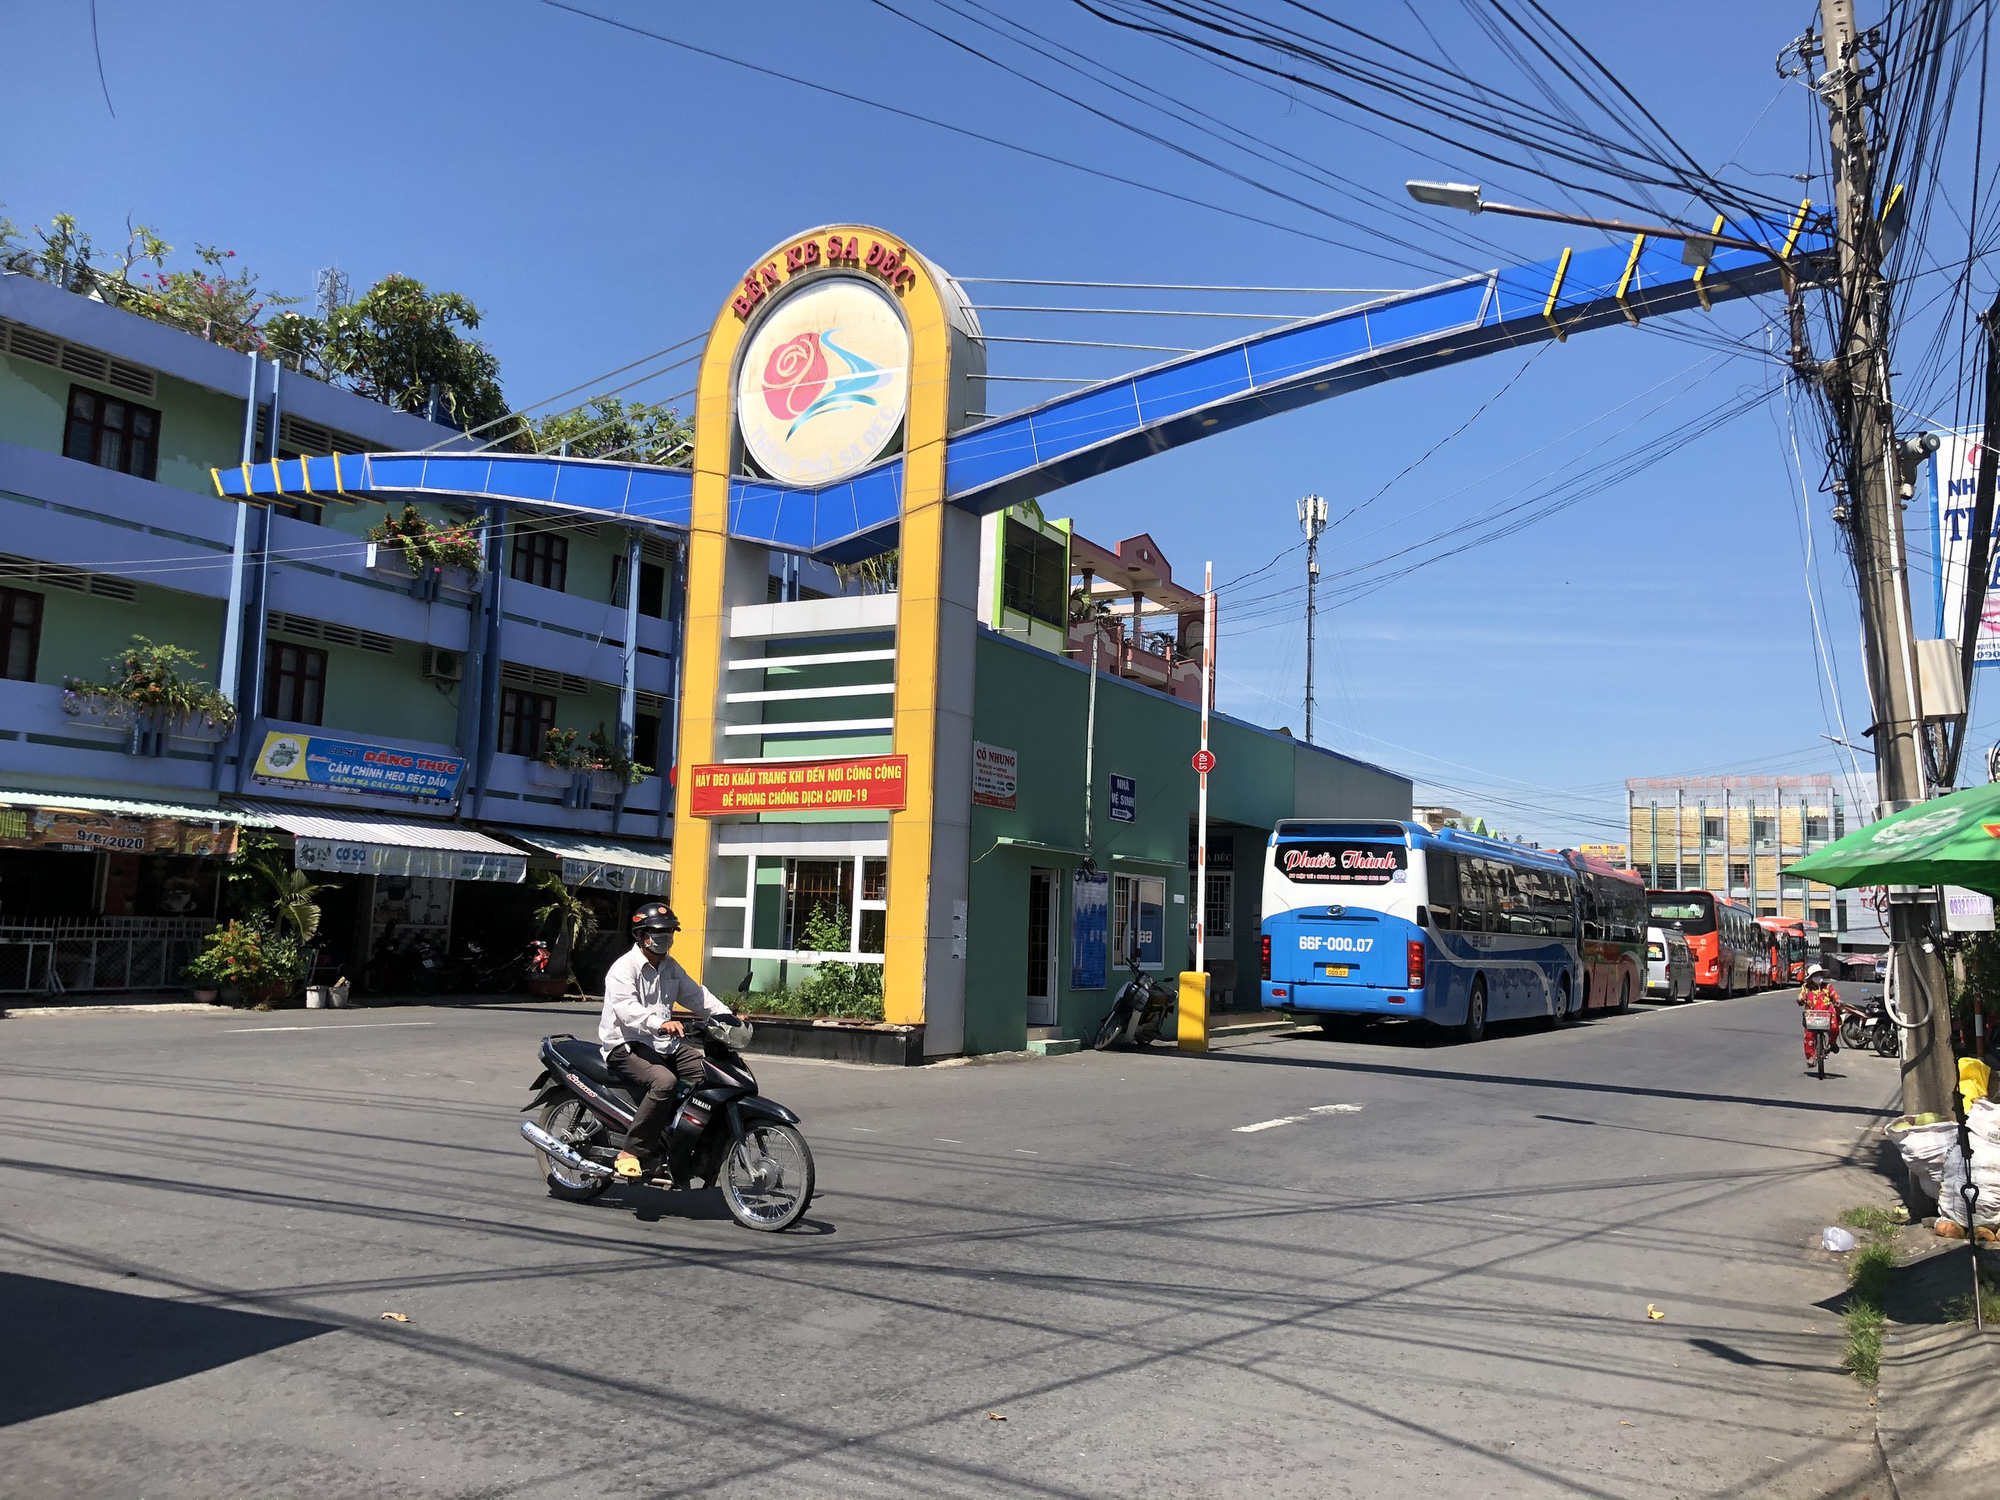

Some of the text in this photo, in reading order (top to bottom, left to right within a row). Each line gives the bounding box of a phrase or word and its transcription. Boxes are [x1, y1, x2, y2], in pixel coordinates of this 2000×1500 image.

[732, 261, 780, 318] BẾN
[785, 240, 819, 273] XE
[827, 236, 859, 261] SA
[838, 443, 863, 467] SA
[364, 751, 460, 774] ĐẶNG THỨC
[976, 747, 1016, 767] CÔ NHUNG
[1199, 753, 1208, 770] STOP
[385, 770, 405, 782] HEO
[712, 773, 730, 787] ĐEO
[731, 768, 756, 786] KHẨU
[758, 771, 787, 785] TRANG
[789, 770, 805, 783] KHI
[806, 765, 825, 783] ĐẾN
[827, 768, 844, 782] NƠI
[846, 765, 872, 780] CÔNG
[874, 764, 902, 783] CỘNG
[1116, 779, 1130, 791] NHÀ
[722, 787, 868, 806] ĐỂ PHÒNG CHỐNG DỊCH COVID-19
[1111, 791, 1135, 807] VỆ SINH
[76, 829, 145, 850] 9/8/2020
[1284, 849, 1398, 871] Phước Thành
[1299, 935, 1374, 953] 66F-000.07
[691, 1097, 712, 1112] YAMAHA
